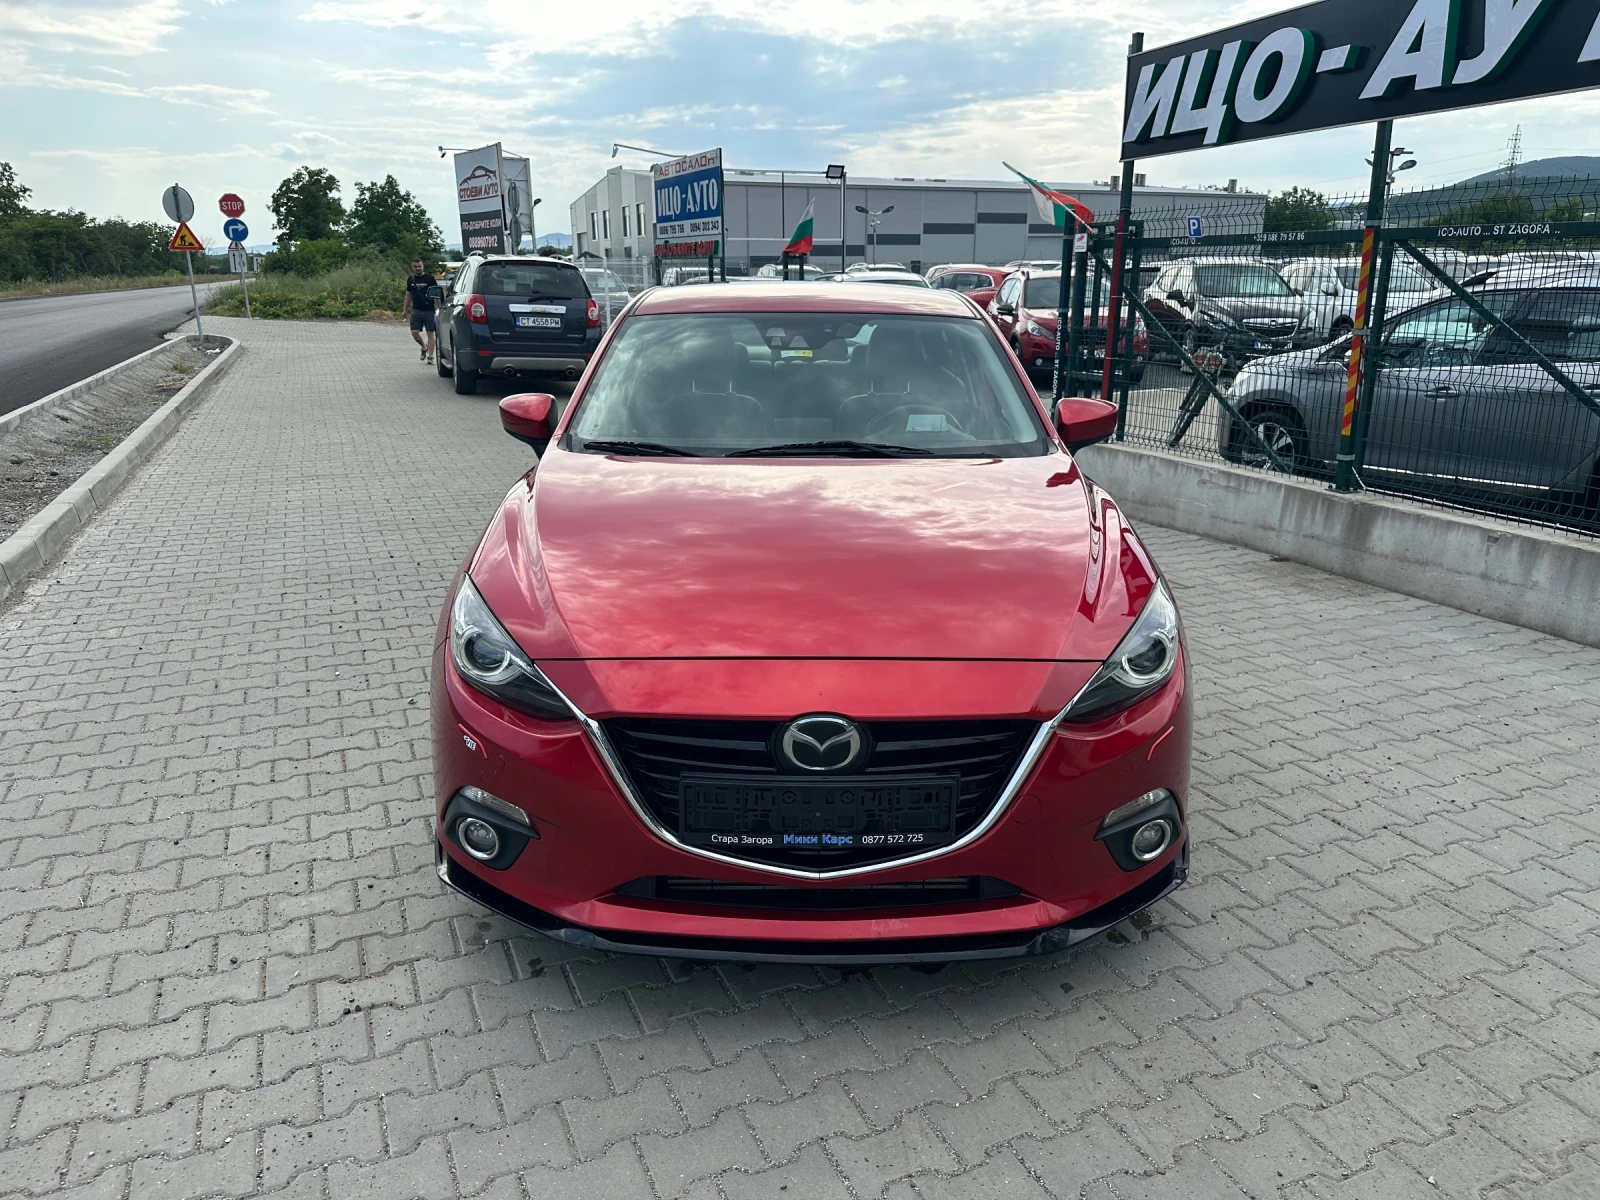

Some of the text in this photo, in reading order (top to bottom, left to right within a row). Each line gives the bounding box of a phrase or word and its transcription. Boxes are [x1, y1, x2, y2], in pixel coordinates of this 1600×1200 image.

[1122, 0, 1600, 145] ИЦО-АУ
[658, 154, 716, 177] АВТОСАЛОН
[459, 182, 499, 199] СТОЕВИ АУТО
[657, 178, 718, 220] ИЦО-АУТО
[221, 201, 242, 211] STOP
[462, 219, 490, 231] ПО-ДОБРИТЕ
[1508, 224, 1550, 234] ZAGORA
[1297, 232, 1305, 240] 86
[520, 317, 560, 327] CT 4558 PM
[711, 833, 773, 846] Стара Загора
[783, 834, 853, 846] Мики Карс
[862, 833, 924, 844] 0877 572 725
